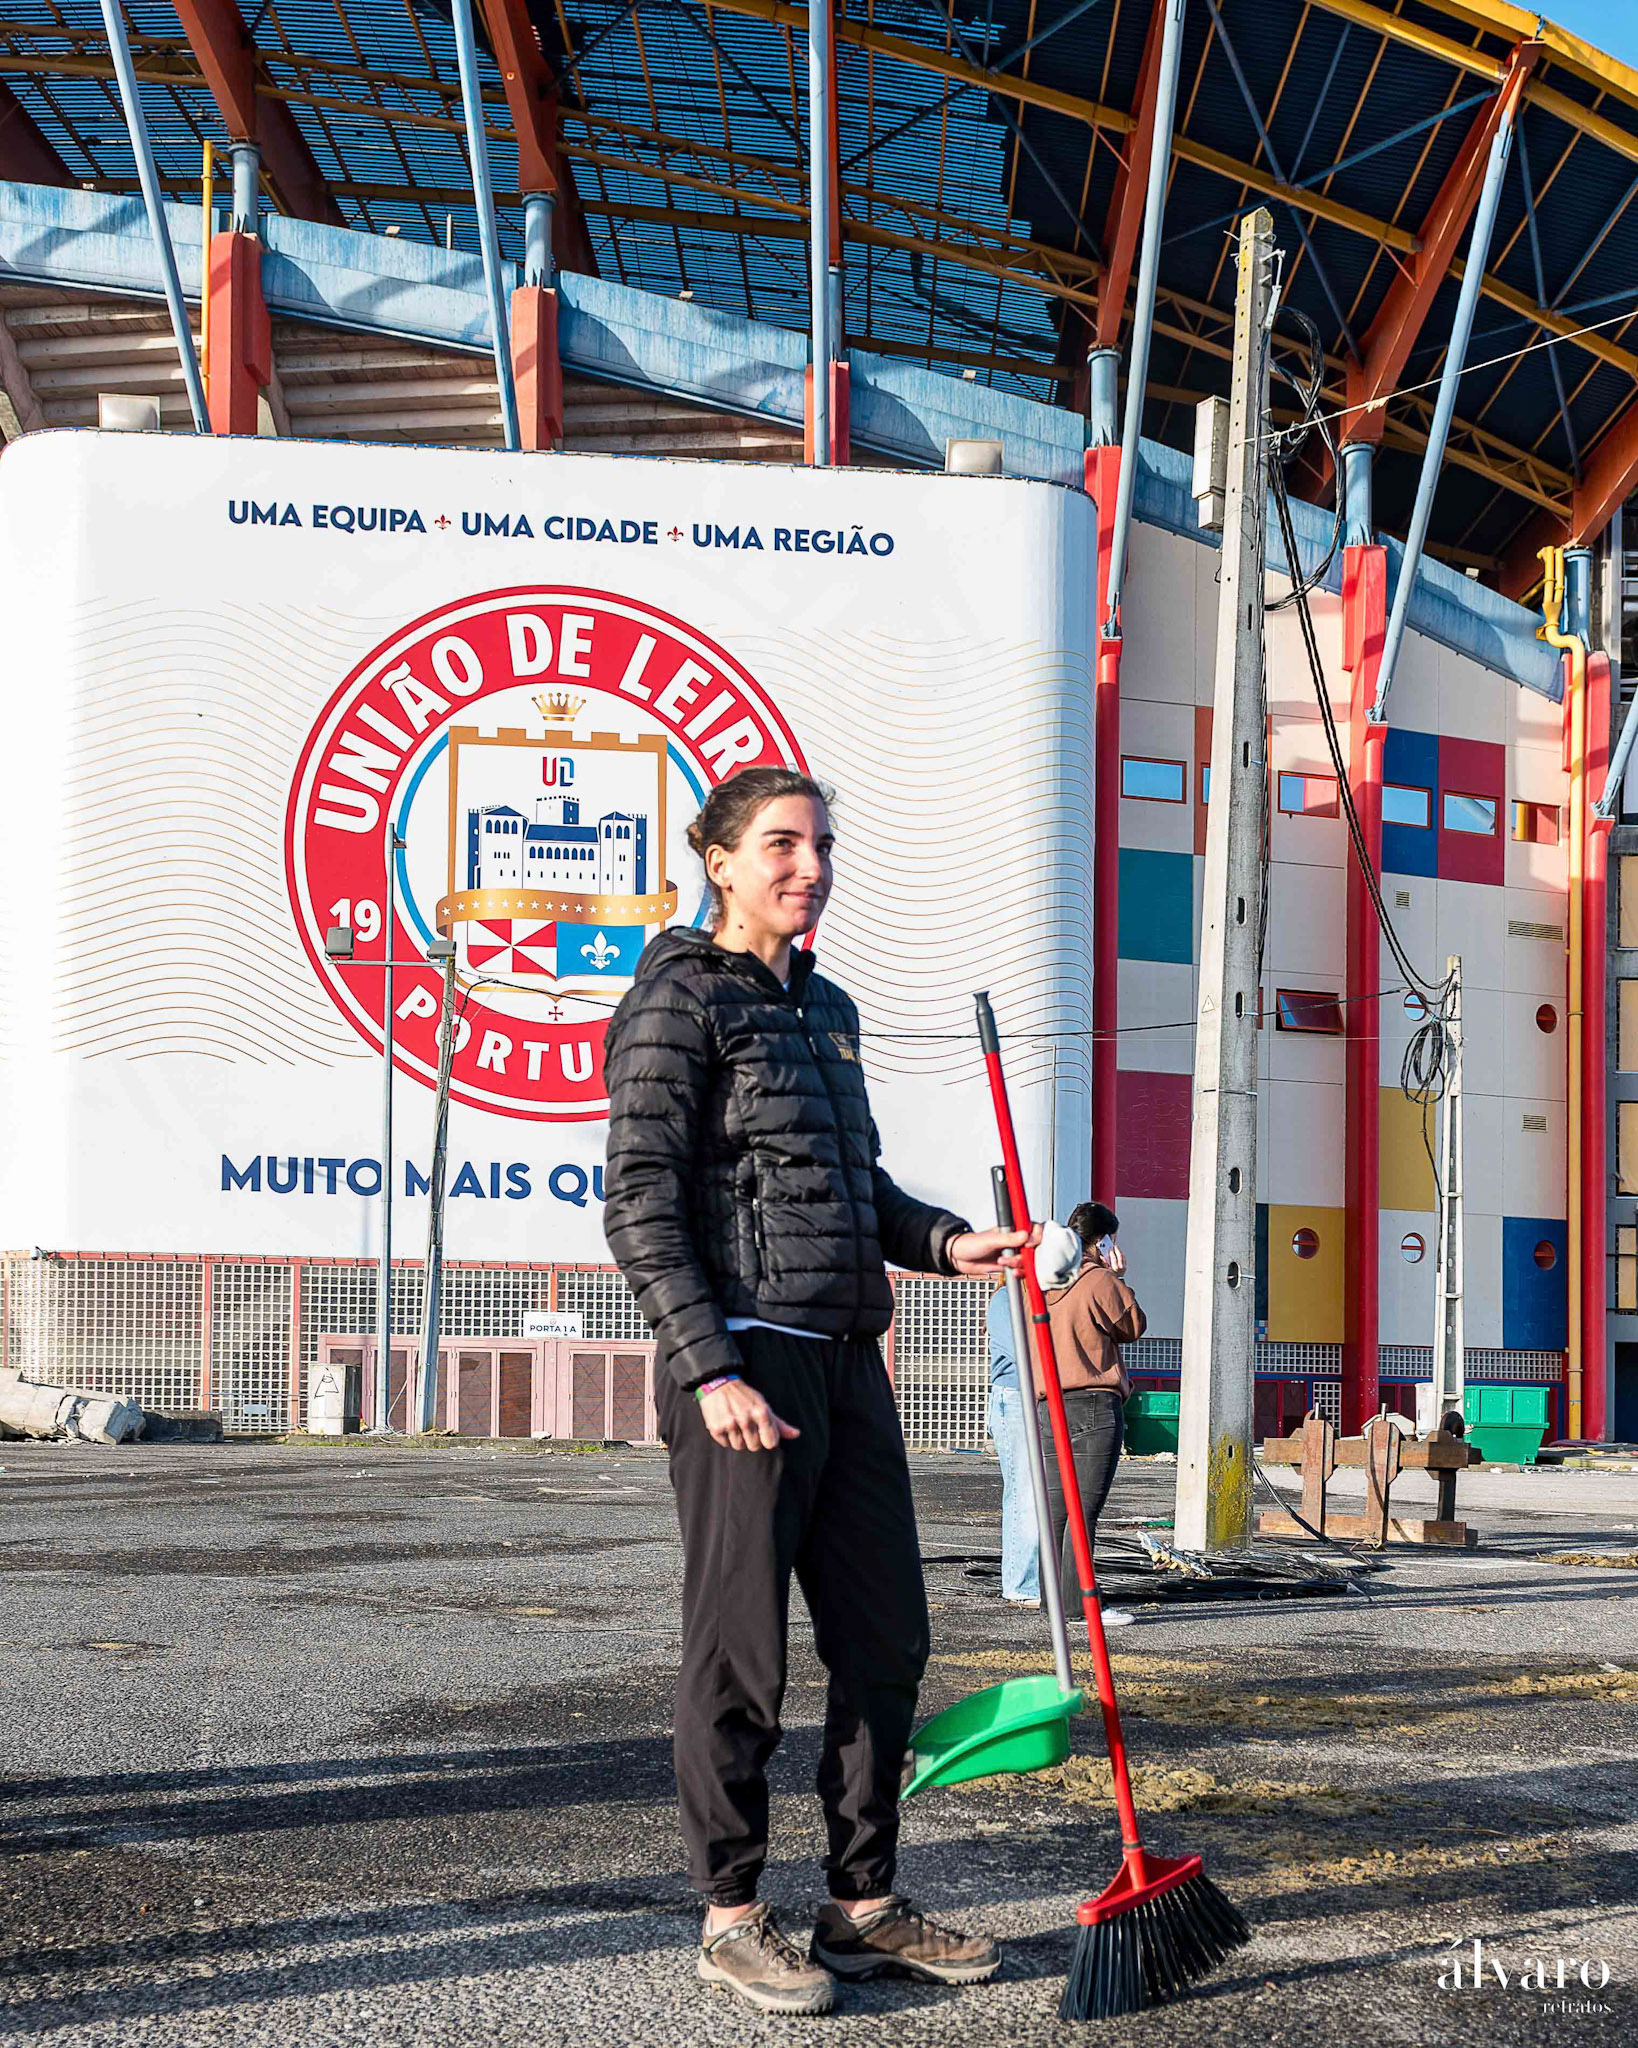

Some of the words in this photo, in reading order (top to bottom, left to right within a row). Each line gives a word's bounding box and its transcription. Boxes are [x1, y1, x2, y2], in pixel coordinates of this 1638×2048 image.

[228, 499, 303, 528] UMA
[312, 504, 428, 535] EQUIPA
[461, 511, 535, 539] UMA
[543, 515, 659, 545] CIDADE
[692, 523, 765, 551] UMA
[774, 524, 895, 557] REGIÃO
[313, 635, 484, 834] UNIÃO
[506, 613, 595, 678] DE
[221, 1153, 382, 1197] MUITO
[405, 1159, 532, 1200] MAIS
[530, 1324, 561, 1332] PORTA
